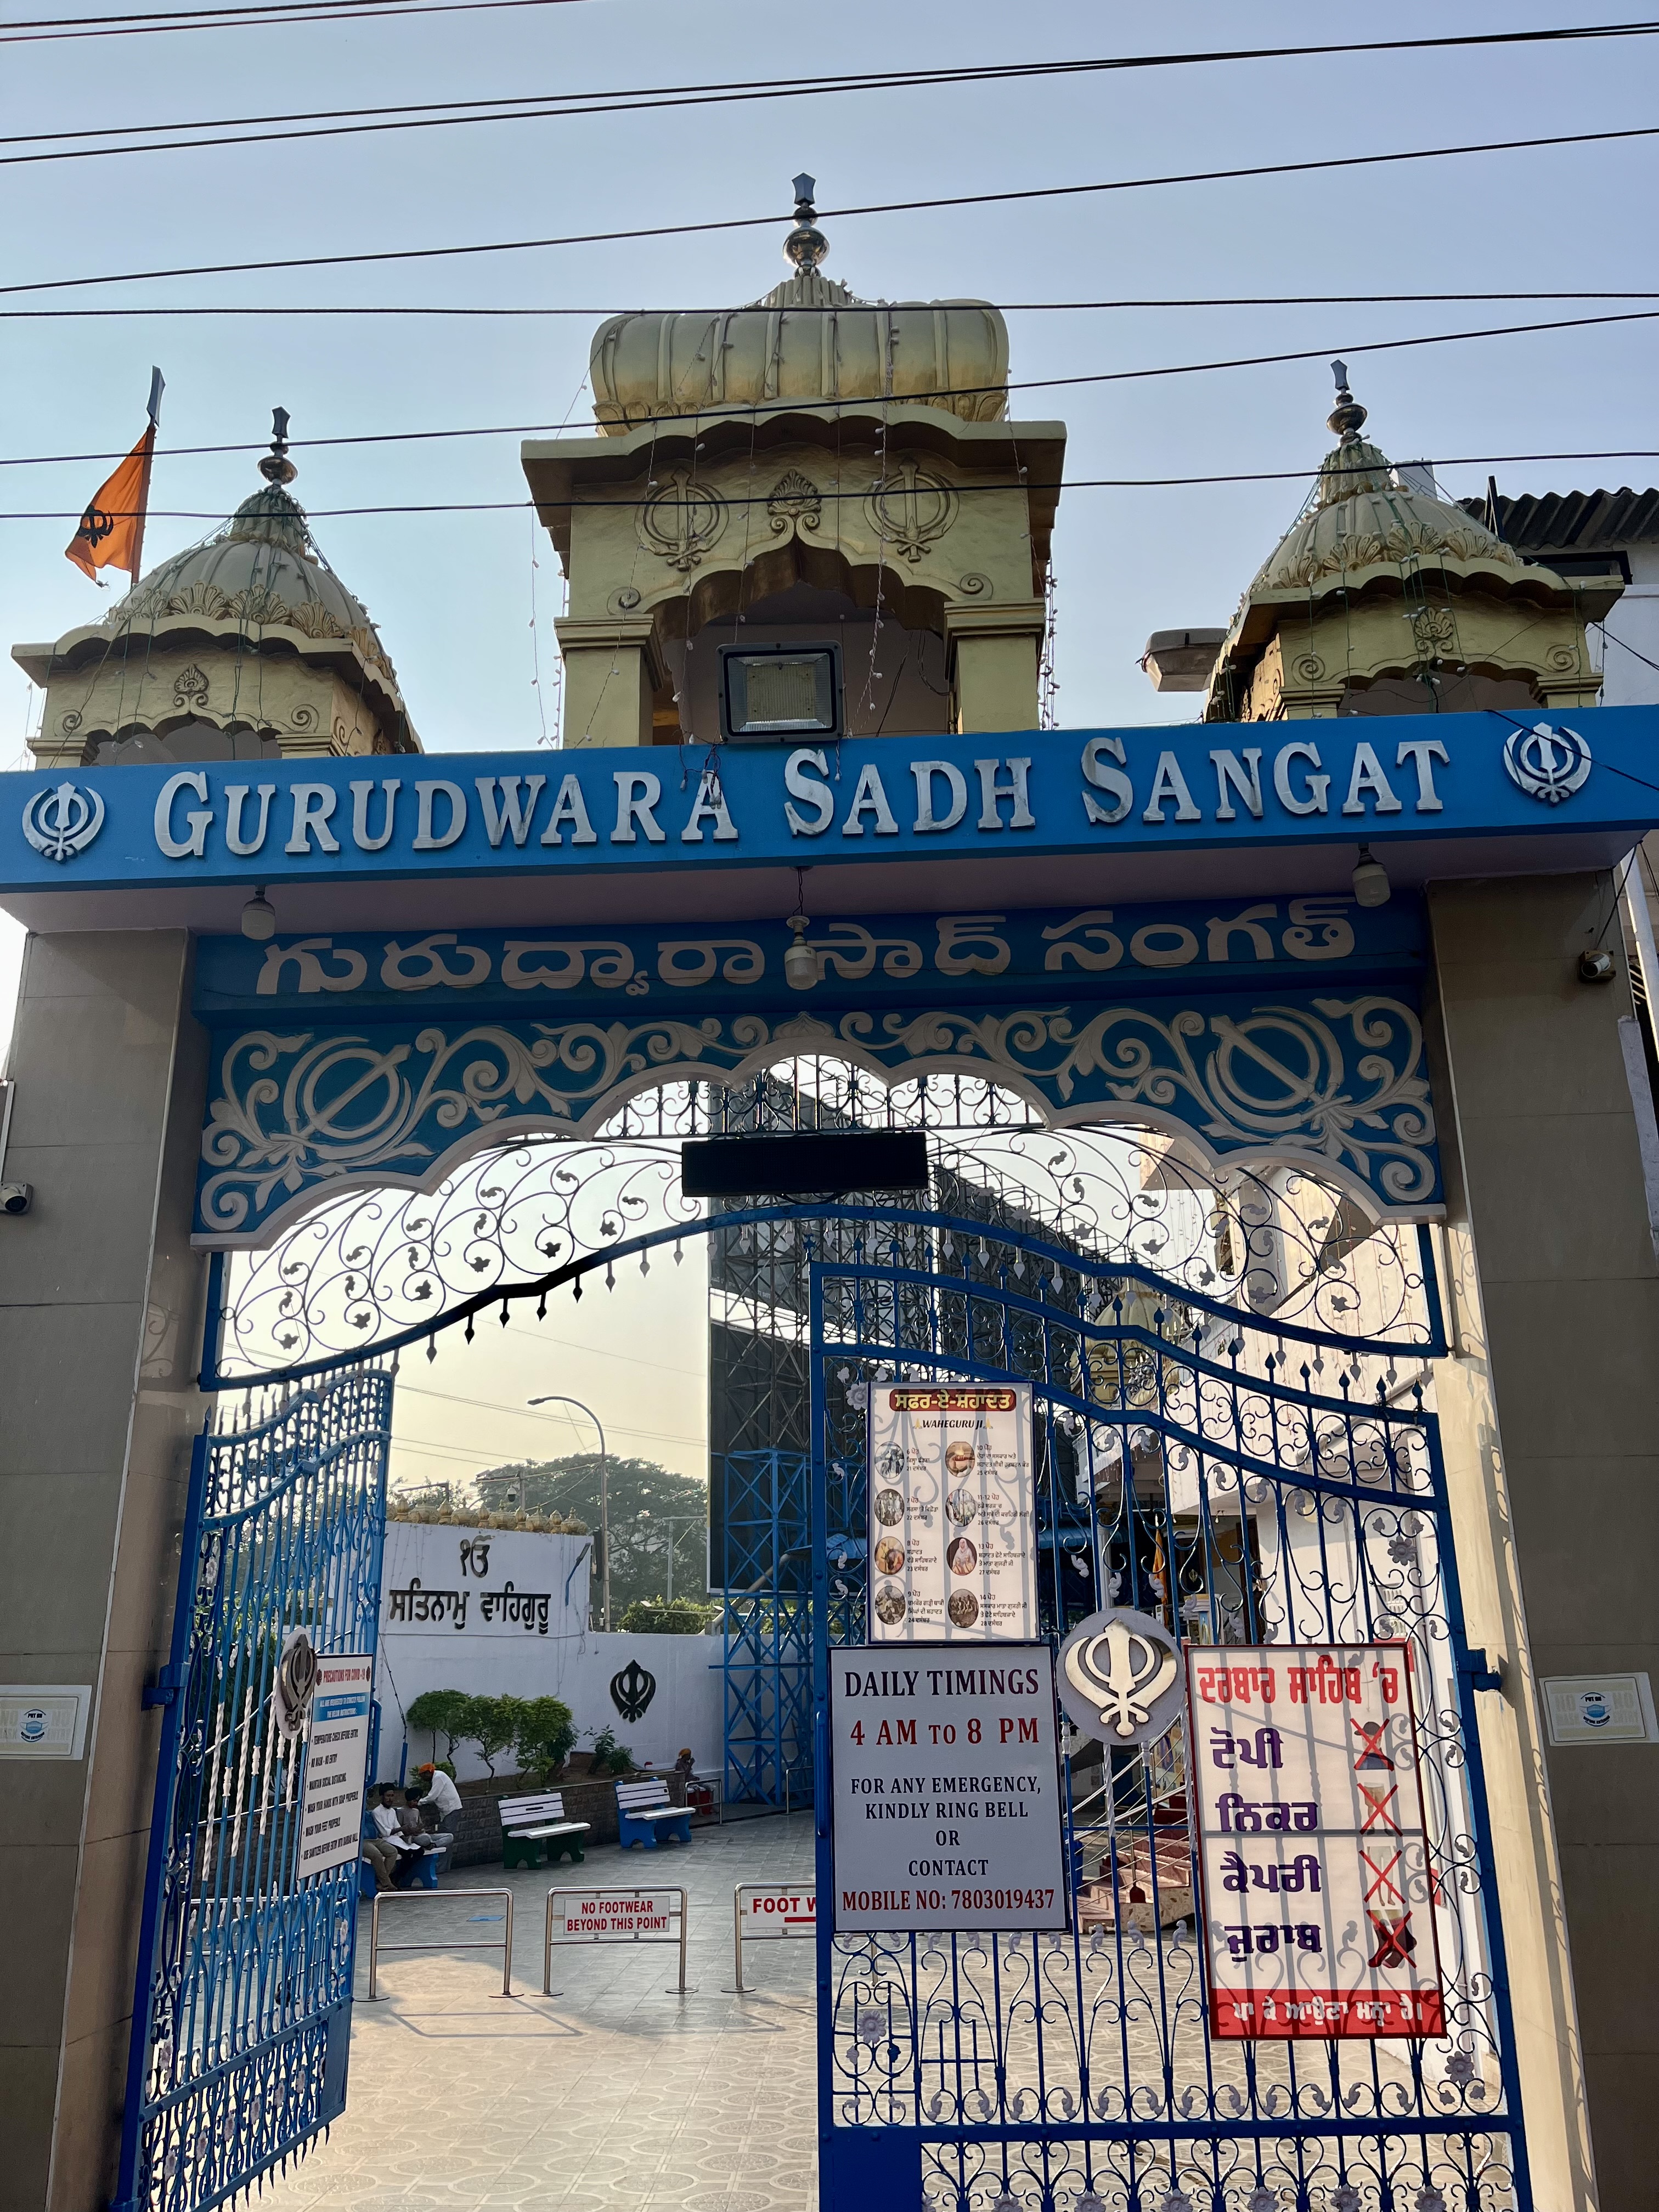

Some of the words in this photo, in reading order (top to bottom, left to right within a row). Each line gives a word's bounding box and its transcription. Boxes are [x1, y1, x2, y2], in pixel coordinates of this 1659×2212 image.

[154, 770, 738, 858] GURUDWARA
[784, 748, 1036, 837] SADH
[1080, 736, 1450, 825] SANGAT
[256, 933, 765, 996] గురుద్వారా
[1041, 896, 1356, 972] సంగత్
[923, 1420, 974, 1428] WAHEGURU
[975, 1420, 984, 1430] JI
[390, 1578, 470, 1629] ਸਤਿਨਾਮੁ
[480, 1581, 551, 1634] ਵਾਹਿਗੁਰੂ
[324, 1669, 345, 1683] PRECAUTIONS
[844, 1671, 919, 1697] DAILY
[927, 1668, 1038, 1695] TIMINGS
[1197, 1667, 1276, 1703] ਦਰਬਾਰ
[1288, 1655, 1361, 1703] ਸਾਹਿਬ
[850, 1720, 865, 1746] 4
[877, 1719, 917, 1745] AM
[967, 1718, 981, 1744] 8
[999, 1718, 1039, 1743] PM
[1210, 1726, 1284, 1769] ਟੋਪੀ
[311, 1758, 315, 1768] NO
[325, 1755, 329, 1764] NO
[329, 1753, 337, 1763] ENTRY
[309, 1779, 321, 1790] MAINTAIN
[322, 1777, 331, 1787] SOCIAL
[851, 1778, 884, 1794] FOR
[890, 1778, 925, 1793] ANY
[932, 1776, 1041, 1795] EMERGENCY,
[323, 1798, 331, 1809] HANDS
[865, 1803, 930, 1819] KINDLY
[936, 1802, 978, 1818] RING
[985, 1802, 1028, 1817] BELL
[1215, 1793, 1318, 1832] ਨਿਕਰ
[306, 1826, 314, 1837] WASH
[936, 1830, 960, 1846] OR
[909, 1859, 989, 1876] CONTACT
[1220, 1851, 1322, 1893] ਕੈਪਰੀ
[582, 1903, 595, 1914] NO
[599, 1900, 653, 1914] FOOTWEAR
[753, 1897, 800, 1913] FOOT
[843, 1891, 910, 1911] MOBILE
[916, 1890, 946, 1909] NO:
[951, 1889, 1054, 1909] 7803019437
[567, 1918, 607, 1931] BEYOND
[611, 1917, 633, 1930] THIS
[637, 1917, 667, 1929] POINT
[1224, 1925, 1322, 1962] ਜੁਰਾਬ
[1233, 2002, 1254, 2021] ਪਾ
[1262, 1996, 1277, 2021] ਕੇ
